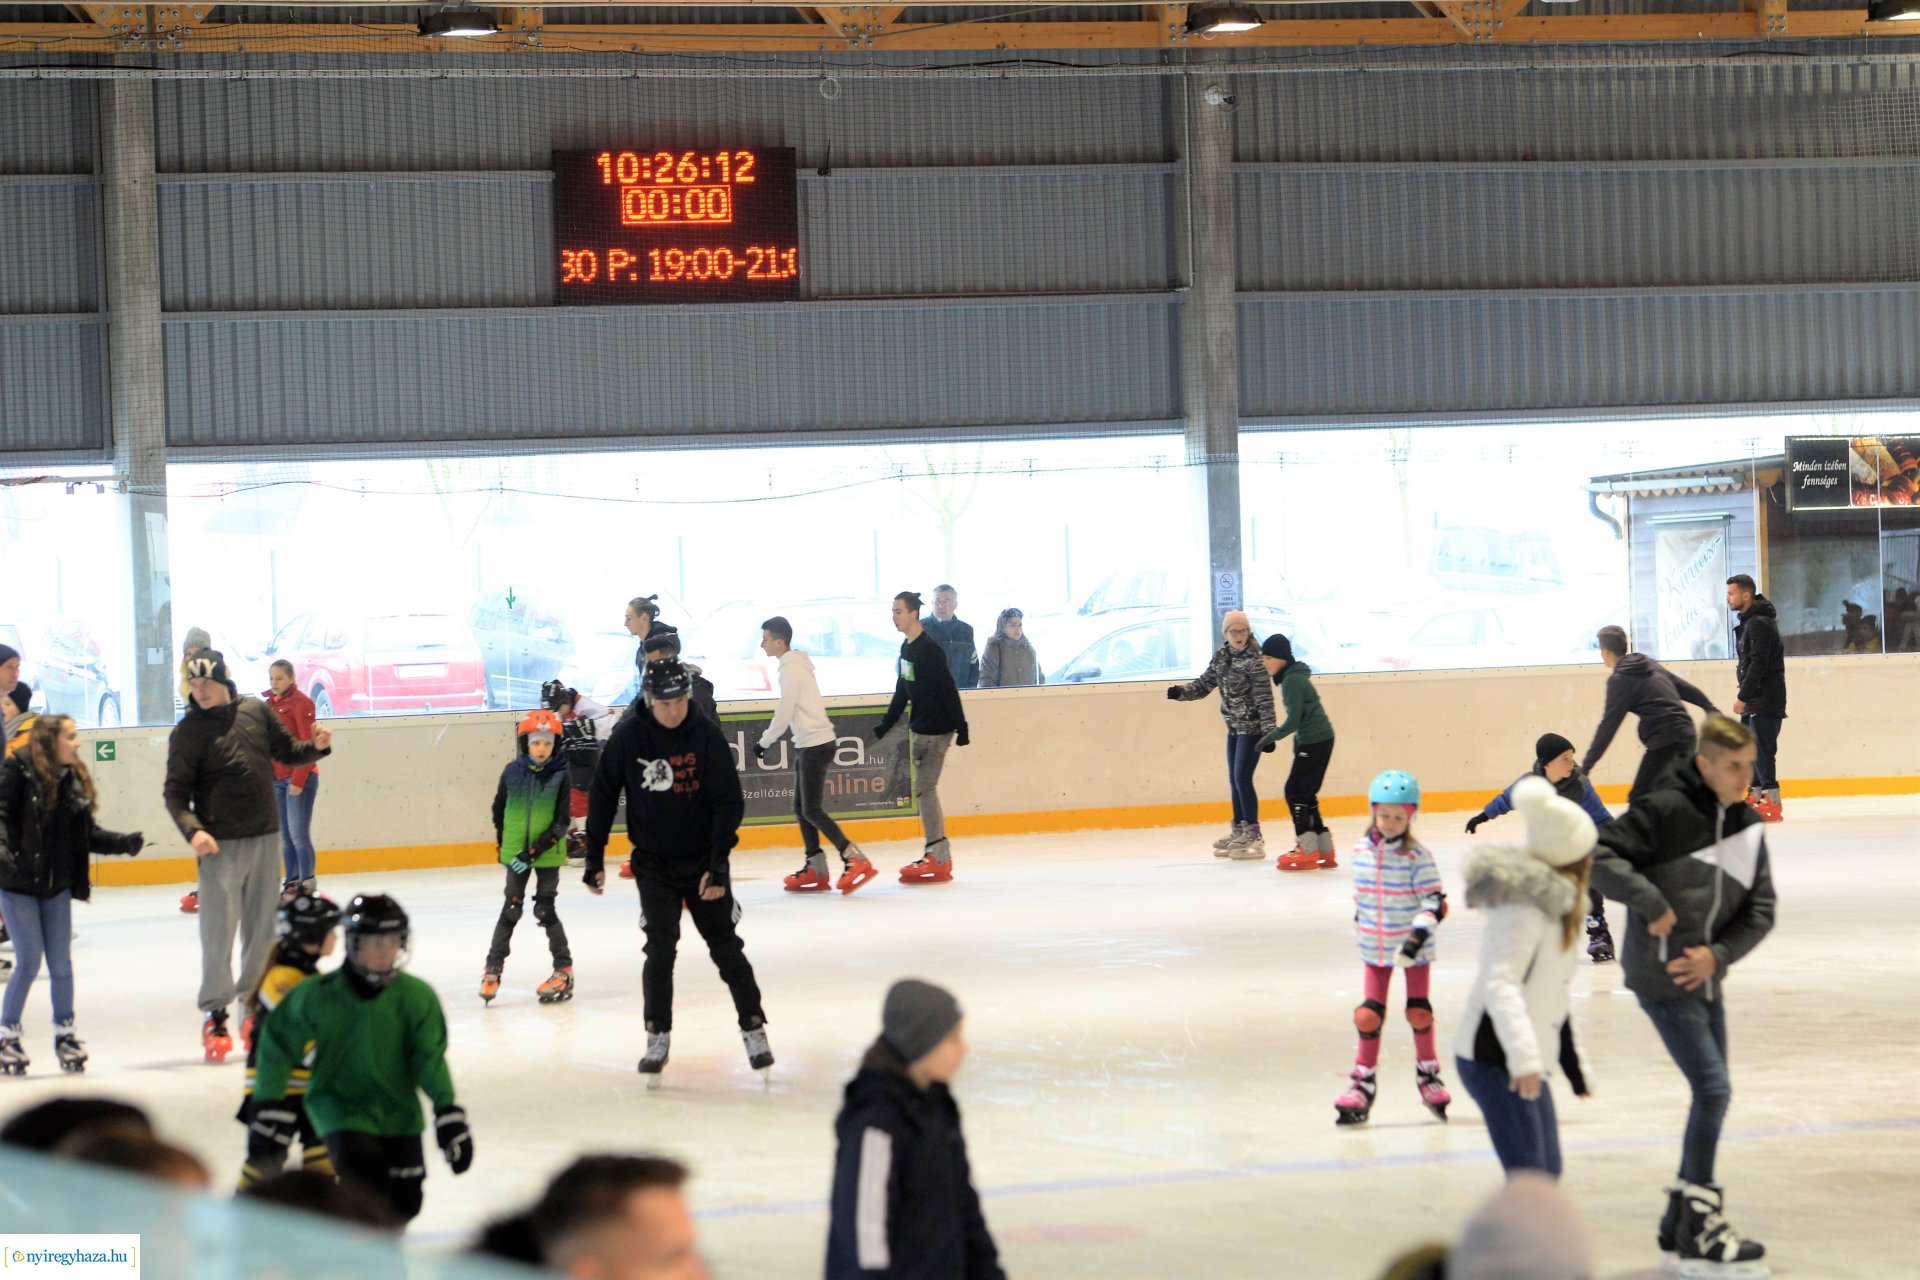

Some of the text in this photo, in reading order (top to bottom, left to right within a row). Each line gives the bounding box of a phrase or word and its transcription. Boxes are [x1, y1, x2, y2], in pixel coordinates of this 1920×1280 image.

[597, 151, 755, 184] 10:26:12
[625, 188, 728, 220] 00:00
[1792, 459, 1822, 472] Minden
[187, 658, 217, 678] NY
